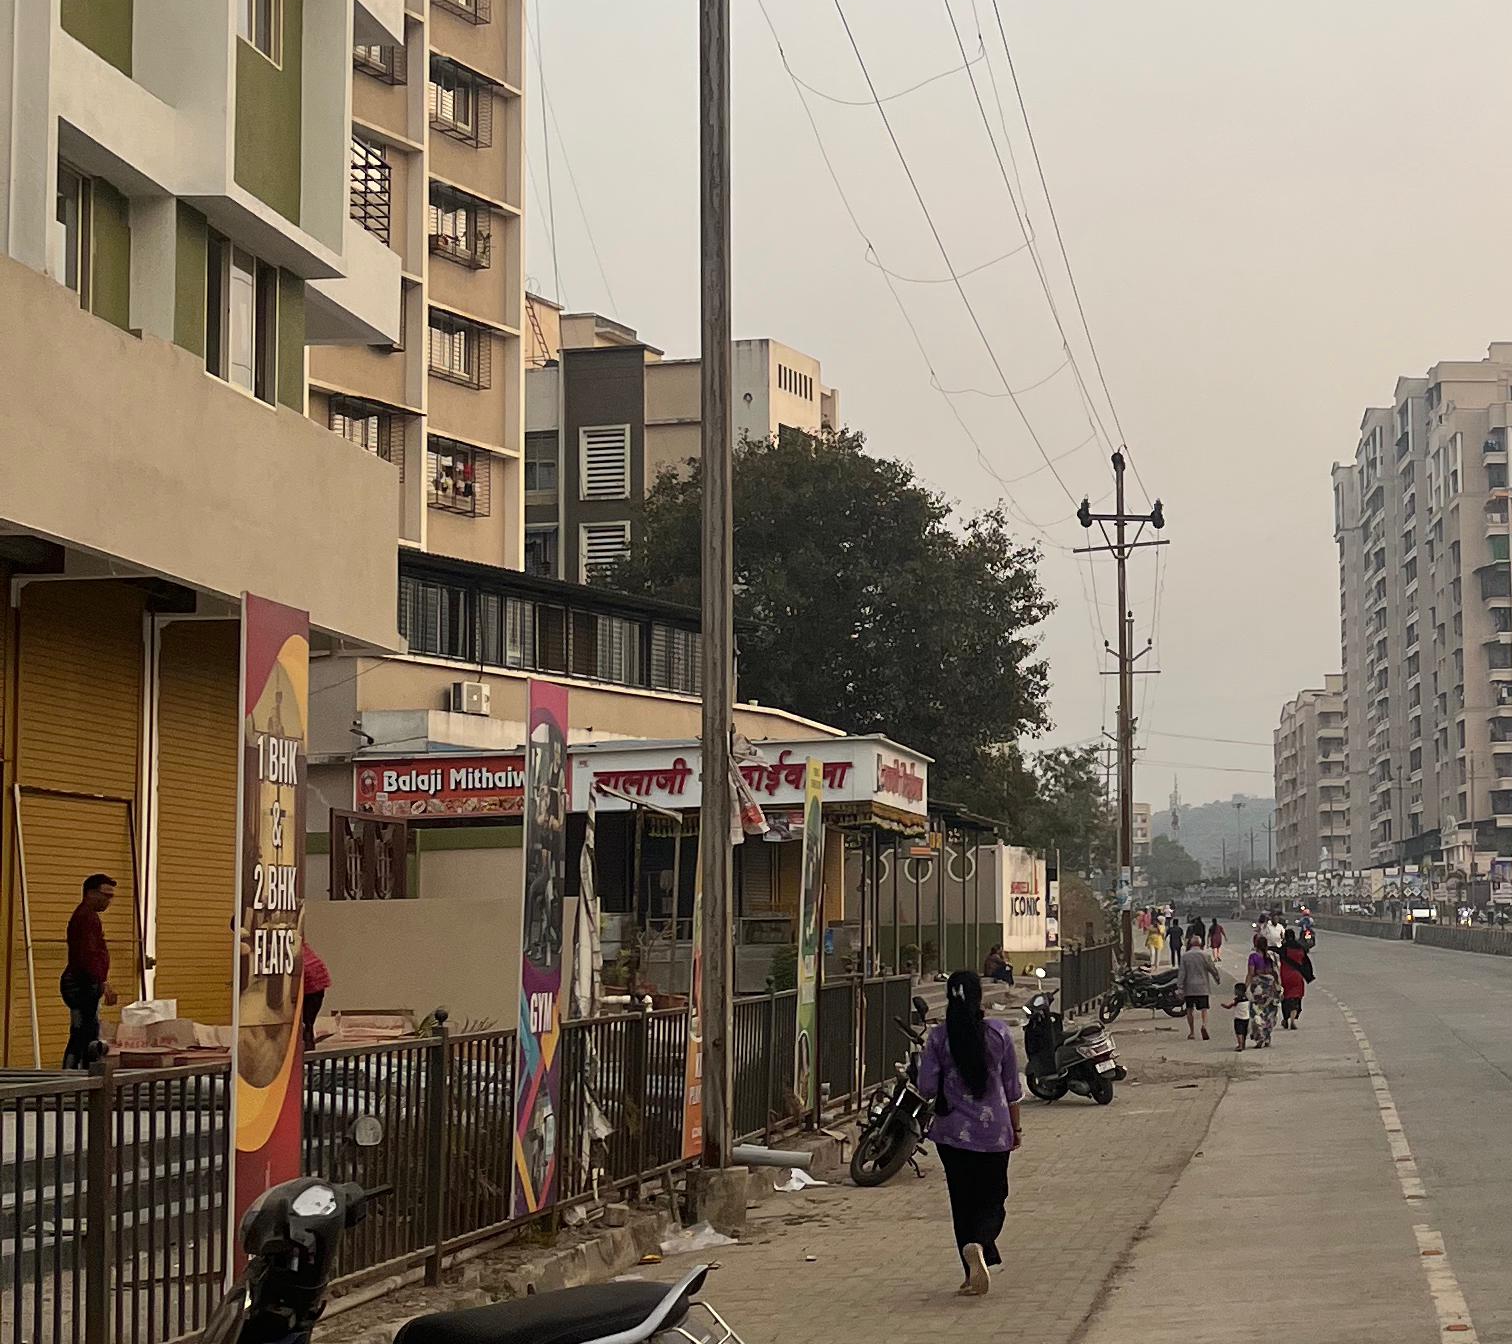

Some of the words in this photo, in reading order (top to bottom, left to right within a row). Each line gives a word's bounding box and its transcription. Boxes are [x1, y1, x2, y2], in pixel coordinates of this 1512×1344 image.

[257, 735, 264, 780] 1
[268, 736, 298, 785] BHK
[383, 768, 442, 796] Balaji
[272, 800, 283, 847] &
[253, 864, 264, 910] 2
[267, 865, 297, 911] BHK
[1010, 896, 1040, 917] ICONIC
[254, 929, 295, 975] FLATS
[530, 991, 553, 1034] GYM
